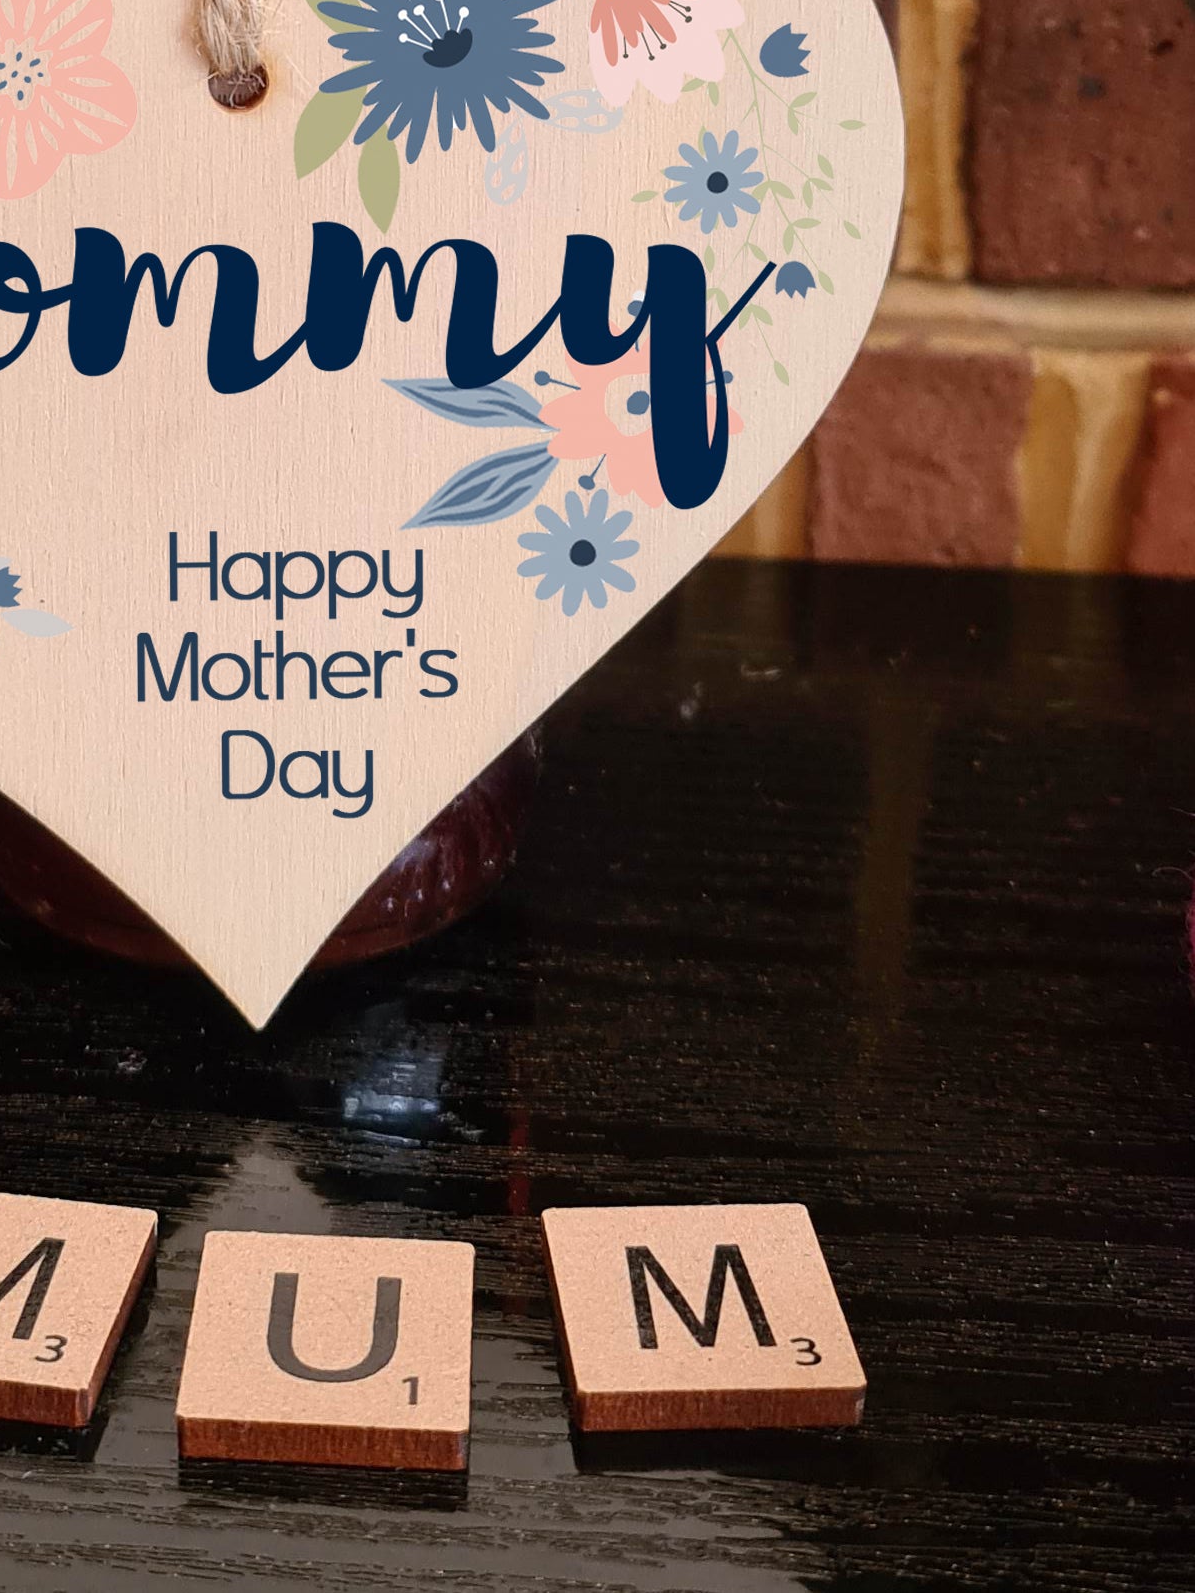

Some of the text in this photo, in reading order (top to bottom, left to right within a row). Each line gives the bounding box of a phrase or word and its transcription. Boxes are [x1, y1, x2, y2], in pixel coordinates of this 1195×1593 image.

[169, 530, 424, 621] Happy
[136, 628, 459, 702] Mother's
[221, 729, 374, 819] Day
